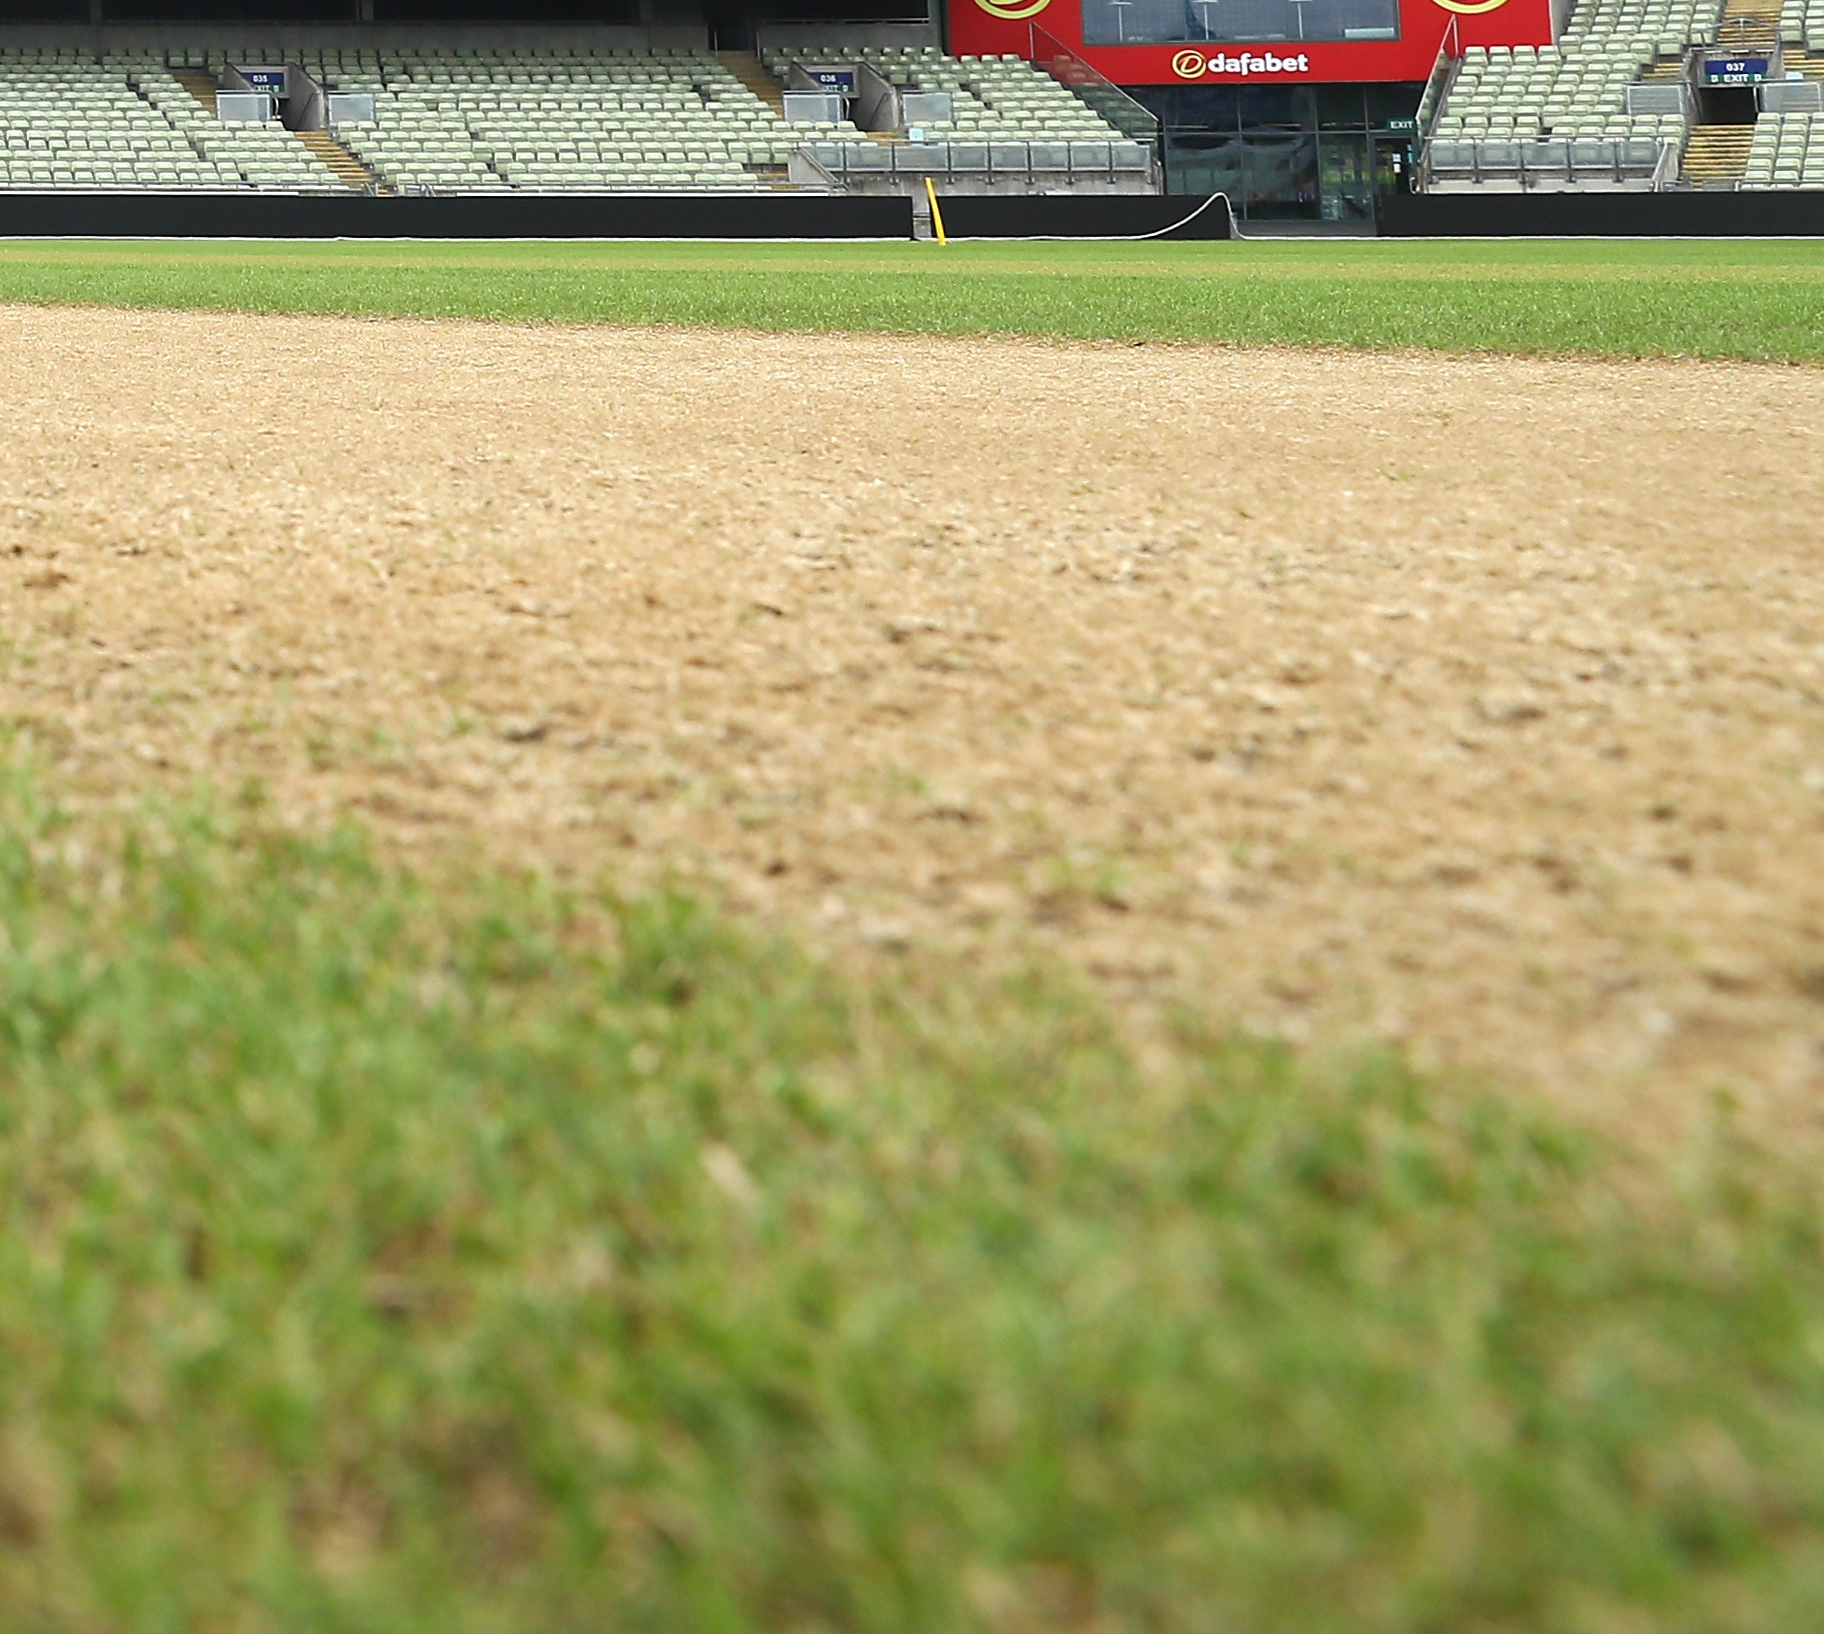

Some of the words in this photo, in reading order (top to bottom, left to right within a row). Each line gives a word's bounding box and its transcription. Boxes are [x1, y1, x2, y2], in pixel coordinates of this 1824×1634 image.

[1208, 53, 1308, 75] dafabet
[1726, 63, 1745, 72] 037
[1723, 74, 1749, 83] EXIT
[1390, 121, 1412, 129] EXIT
